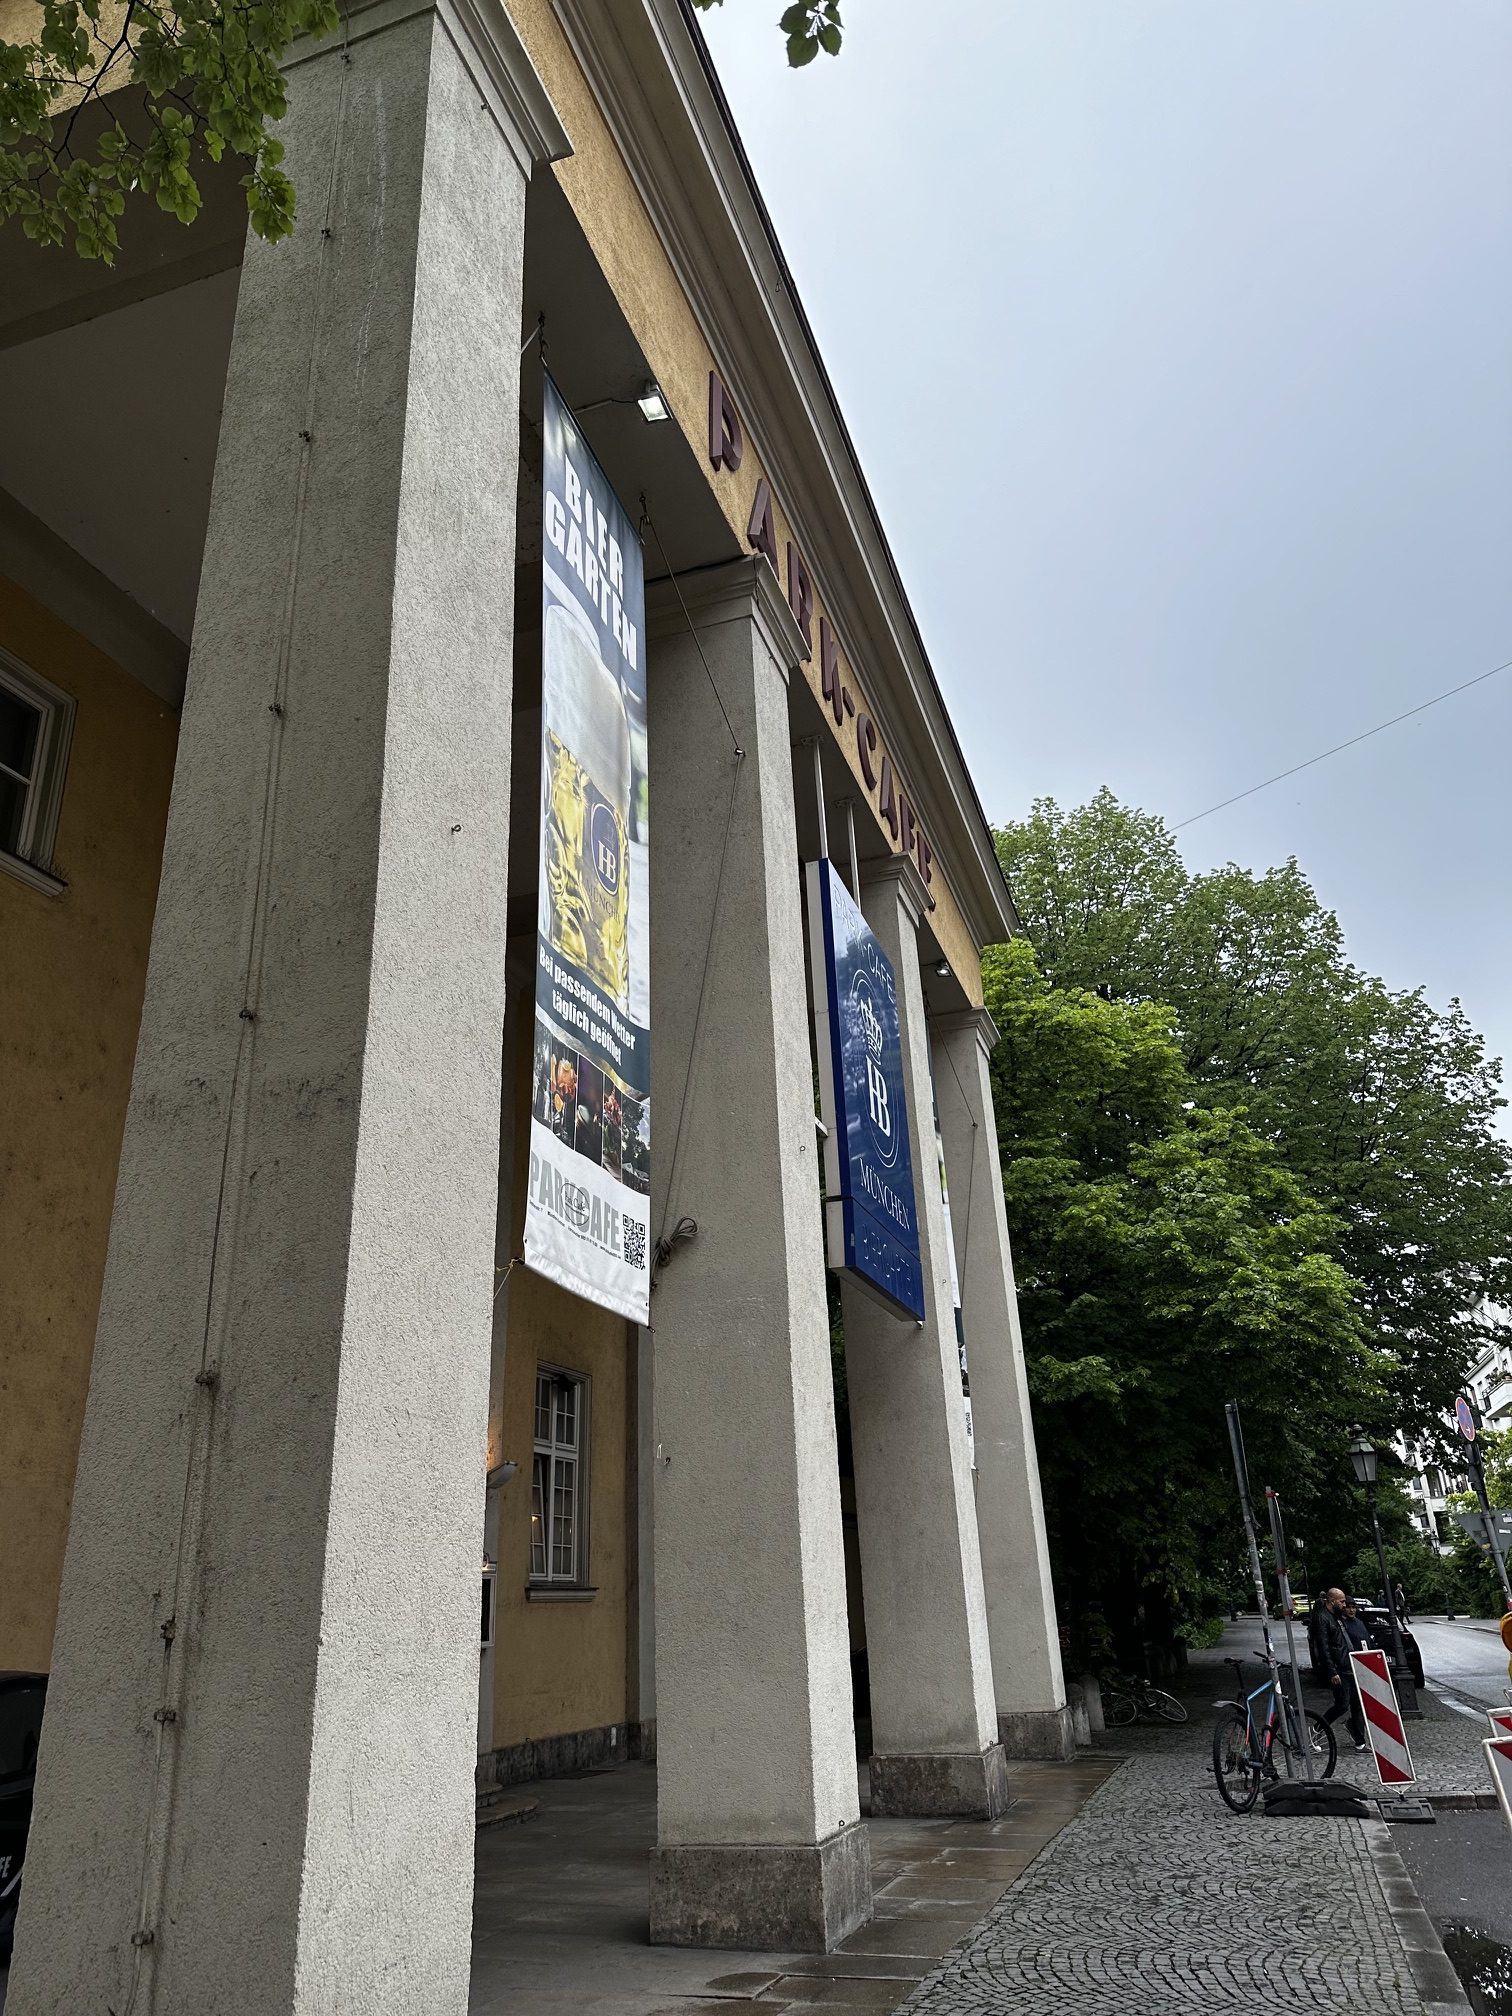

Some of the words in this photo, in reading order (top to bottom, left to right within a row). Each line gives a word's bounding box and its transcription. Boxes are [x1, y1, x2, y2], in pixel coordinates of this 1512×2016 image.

[545, 490, 637, 671] GARTEN
[565, 454, 623, 601] BIER
[708, 370, 932, 885] PARK-CAFE
[540, 944, 553, 977] Bei
[554, 964, 611, 1025] passendem
[611, 1010, 636, 1050] Wetter
[552, 989, 590, 1034] täglich
[590, 1021, 622, 1067] geöffnet
[860, 1158, 910, 1231] MÜNCHEN
